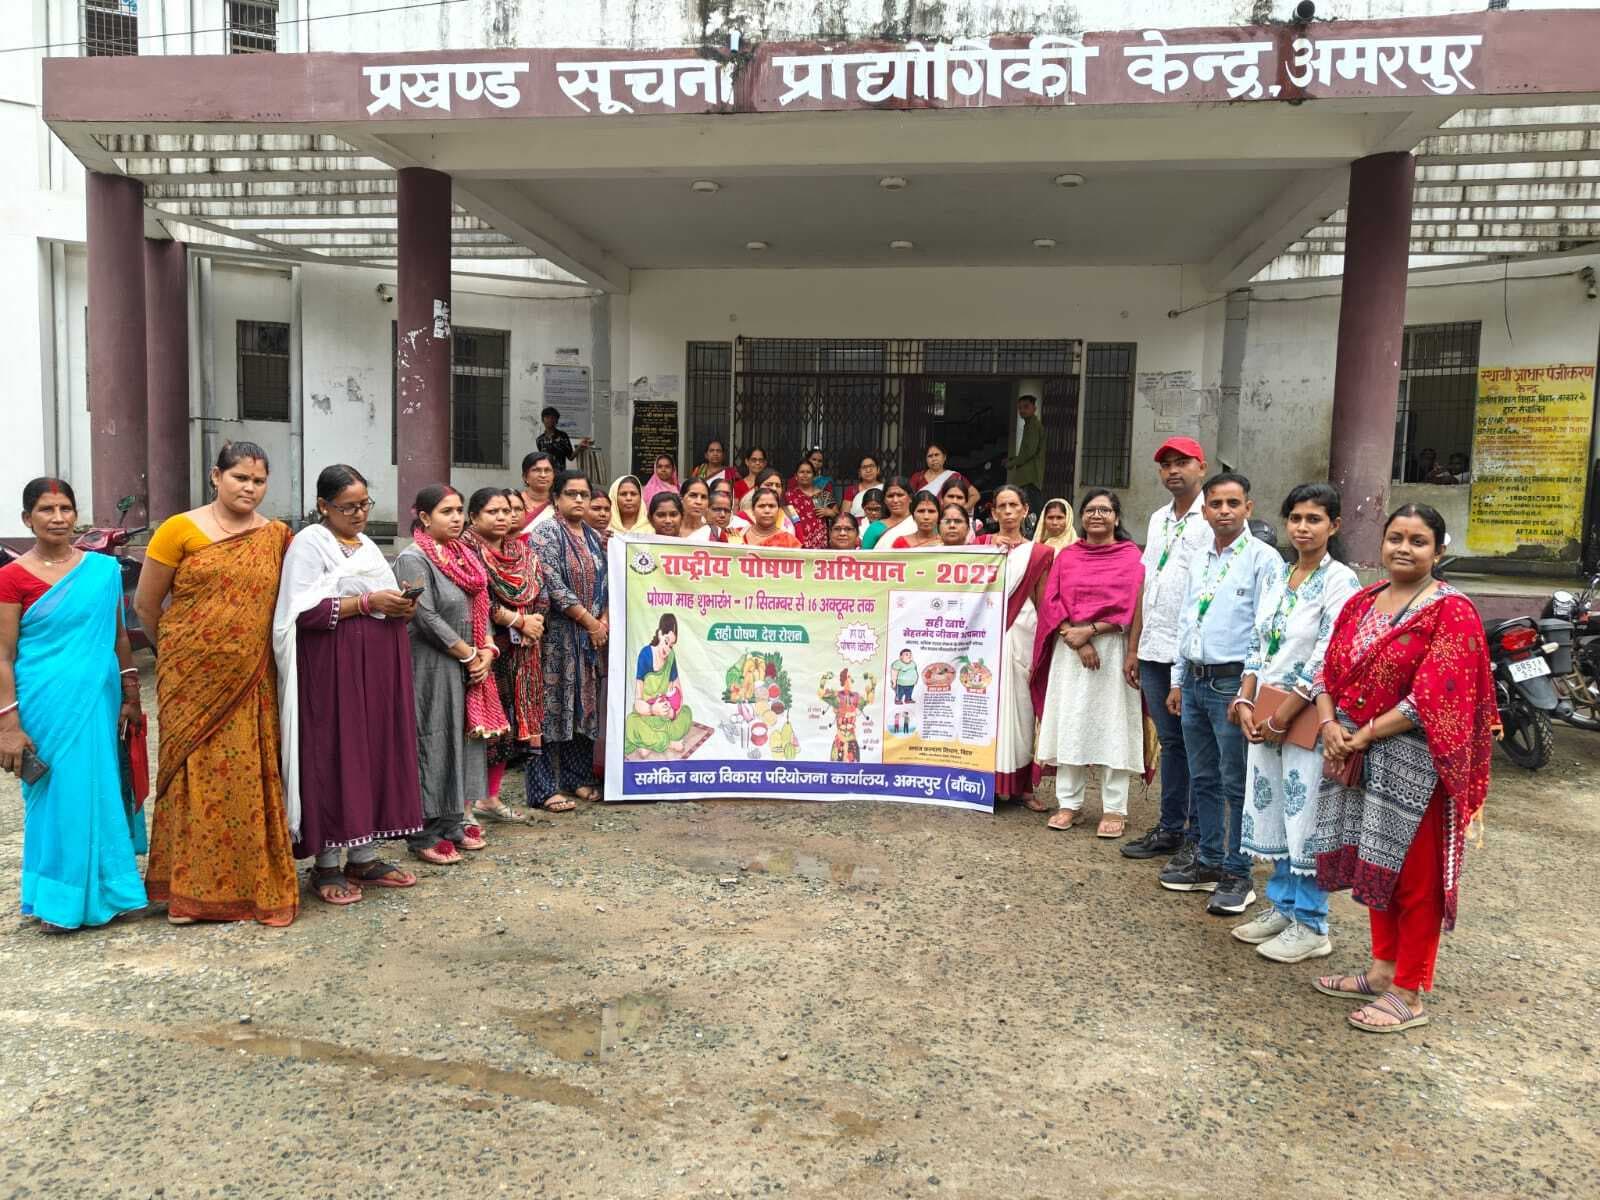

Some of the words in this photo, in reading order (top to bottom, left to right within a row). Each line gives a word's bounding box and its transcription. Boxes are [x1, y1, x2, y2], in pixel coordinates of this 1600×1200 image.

[363, 62, 529, 115] प्रखण्ड
[556, 58, 734, 114] सूचना
[1285, 35, 1482, 95] अमरपुर
[1513, 368, 1544, 382] आधार
[661, 550, 731, 580] राष्ट्रीय
[738, 553, 805, 579] पोषण
[814, 556, 905, 582] अभियान
[647, 587, 673, 608] पोषण
[675, 591, 694, 609] माह
[698, 590, 732, 615] शुभारंभ
[744, 597, 753, 610] 17
[756, 590, 793, 612] सितम्बर
[796, 592, 805, 612] से
[808, 599, 817, 612] 16
[819, 597, 855, 619] अक्टूबर
[856, 598, 876, 613] तक
[925, 616, 943, 628] सही
[714, 626, 731, 641] सही
[762, 626, 776, 642] देश
[778, 627, 802, 642] रोशन
[936, 628, 958, 639] जीवन
[634, 767, 686, 785] समेकित
[690, 770, 715, 785] बाल
[720, 766, 761, 785] विकास
[765, 767, 827, 785] परियोजना
[831, 769, 888, 788] कार्यालय,
[893, 774, 942, 795] अमरपुर
